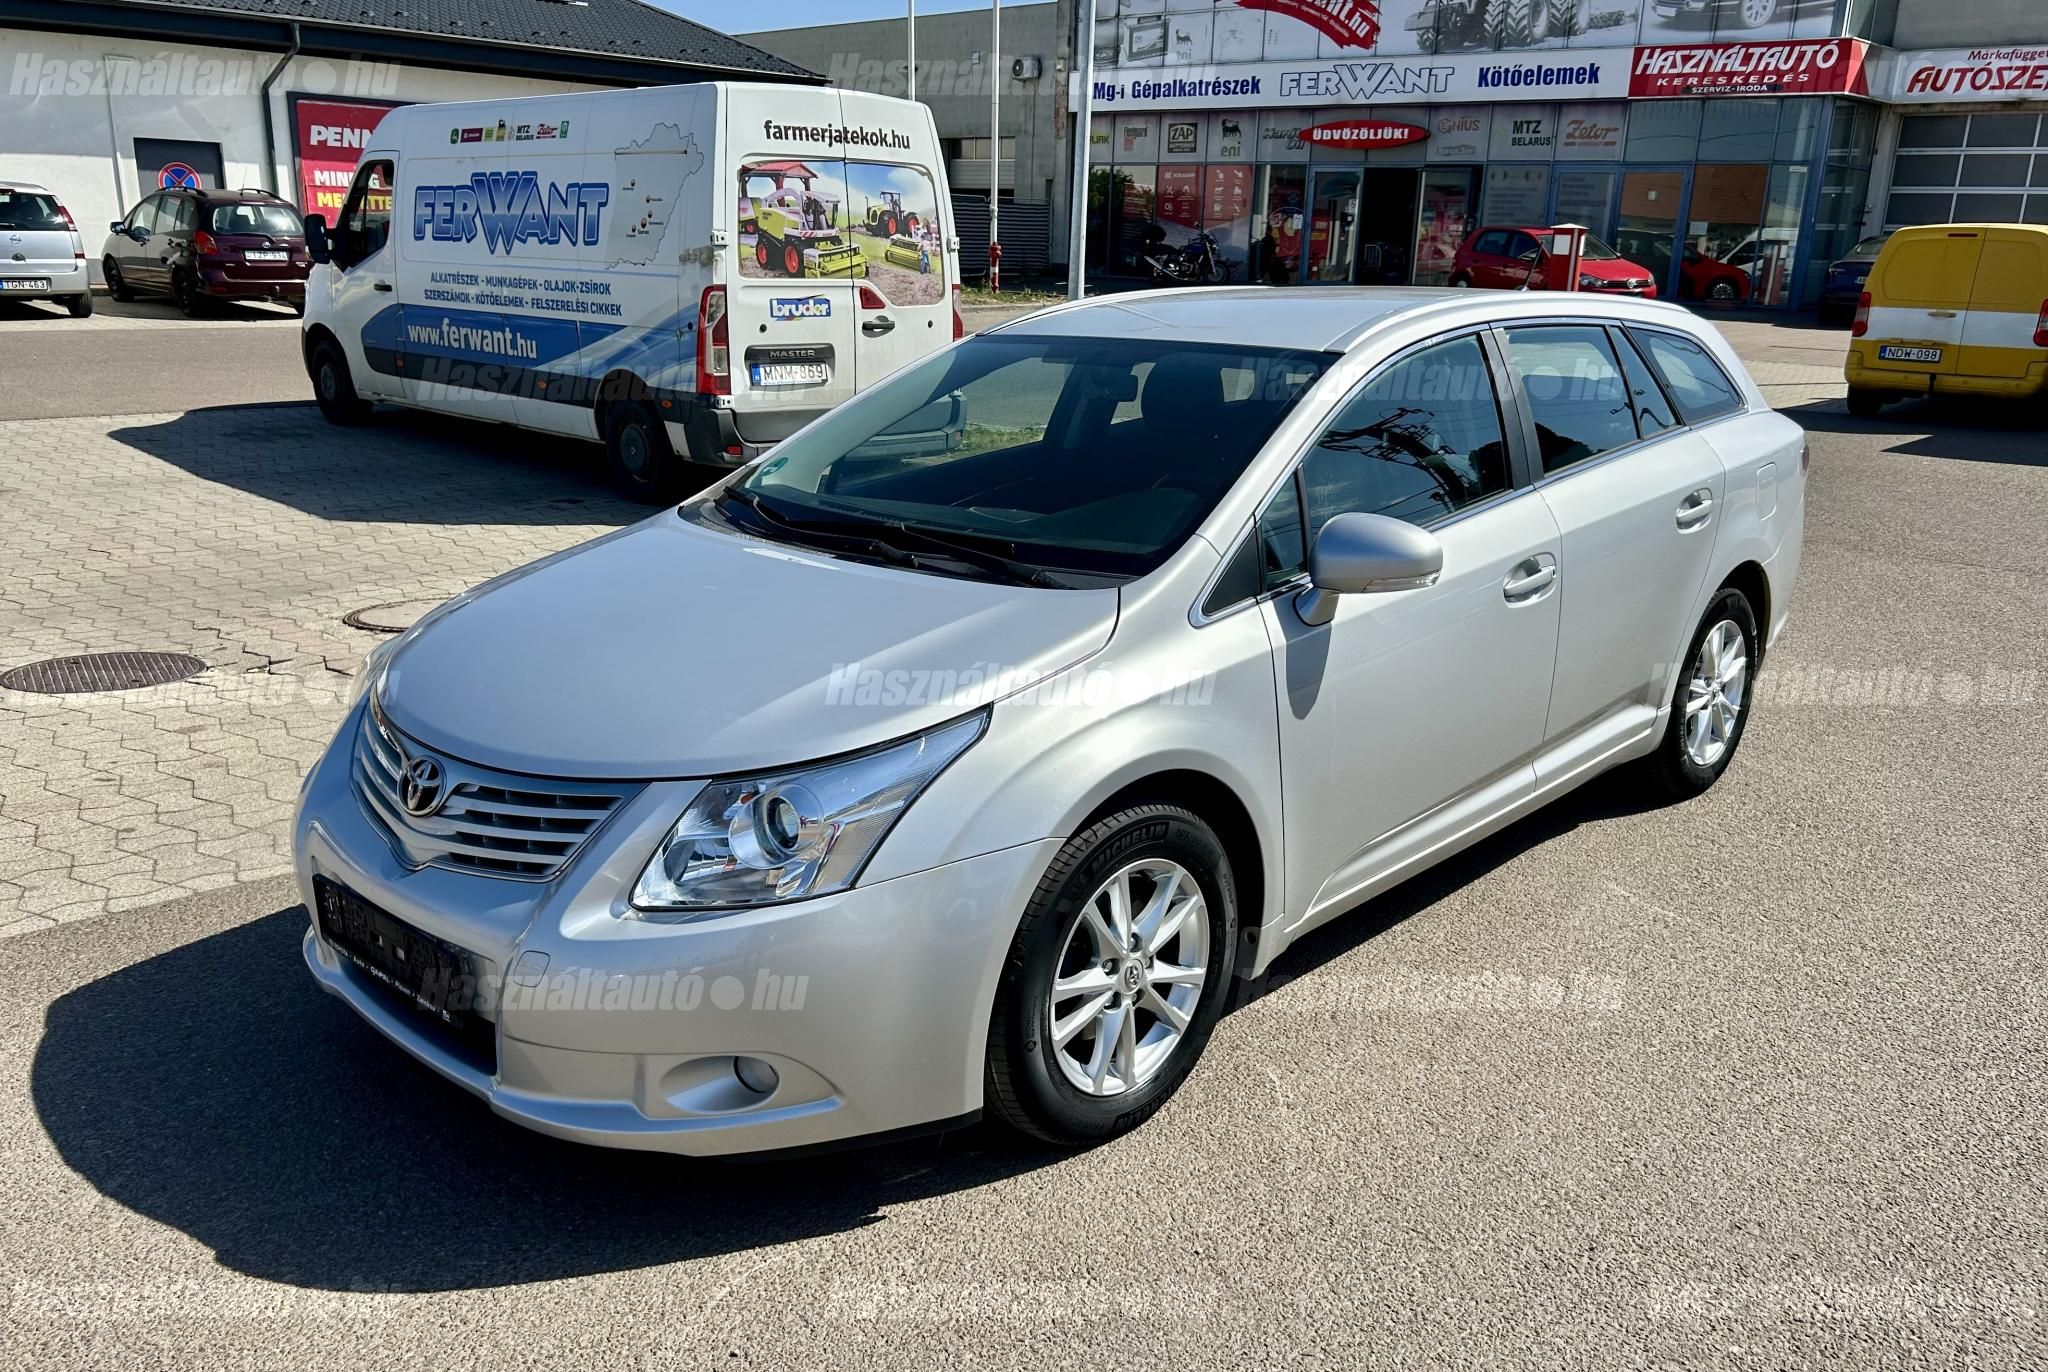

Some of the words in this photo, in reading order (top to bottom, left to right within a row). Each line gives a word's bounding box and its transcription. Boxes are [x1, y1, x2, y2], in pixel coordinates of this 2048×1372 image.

[1635, 40, 1839, 74] HASZNÁLTAUTÓ
[1280, 63, 1455, 100] FERWANT
[1477, 63, 1600, 88] Kötőelemek
[1656, 73, 1810, 87] KERESKEDÉS
[1907, 61, 2048, 94] AUTÓSZE
[1131, 75, 1261, 100] Gépalkatrészek
[1692, 84, 1768, 94] SZERVIZ-IRODA
[764, 120, 910, 150] farmerjatekok.hu
[1171, 126, 1194, 141] ZAP
[1313, 127, 1409, 141] ÜDVÖZÖLJÜK!
[1512, 120, 1542, 134] MTZ
[1567, 119, 1619, 140] Zetor
[1220, 141, 1241, 157] eni
[1511, 136, 1551, 147] BELARUS
[414, 171, 609, 255] FERWANT
[5, 280, 46, 289] TGN-463
[430, 271, 479, 287] ALKATRÉSZEK
[485, 275, 538, 290] MUNKAGÉPEK
[543, 279, 612, 296] OLAJOK-ZSÍROK
[424, 288, 471, 305] SZERSZÁMOK
[531, 296, 589, 314] FELSZERELÉSI
[590, 300, 623, 317] CIKKEK
[772, 301, 830, 318] bruder
[408, 318, 538, 360] www.ferwant.hu
[769, 350, 816, 359] MASTER
[1887, 347, 1938, 361] NDW-098
